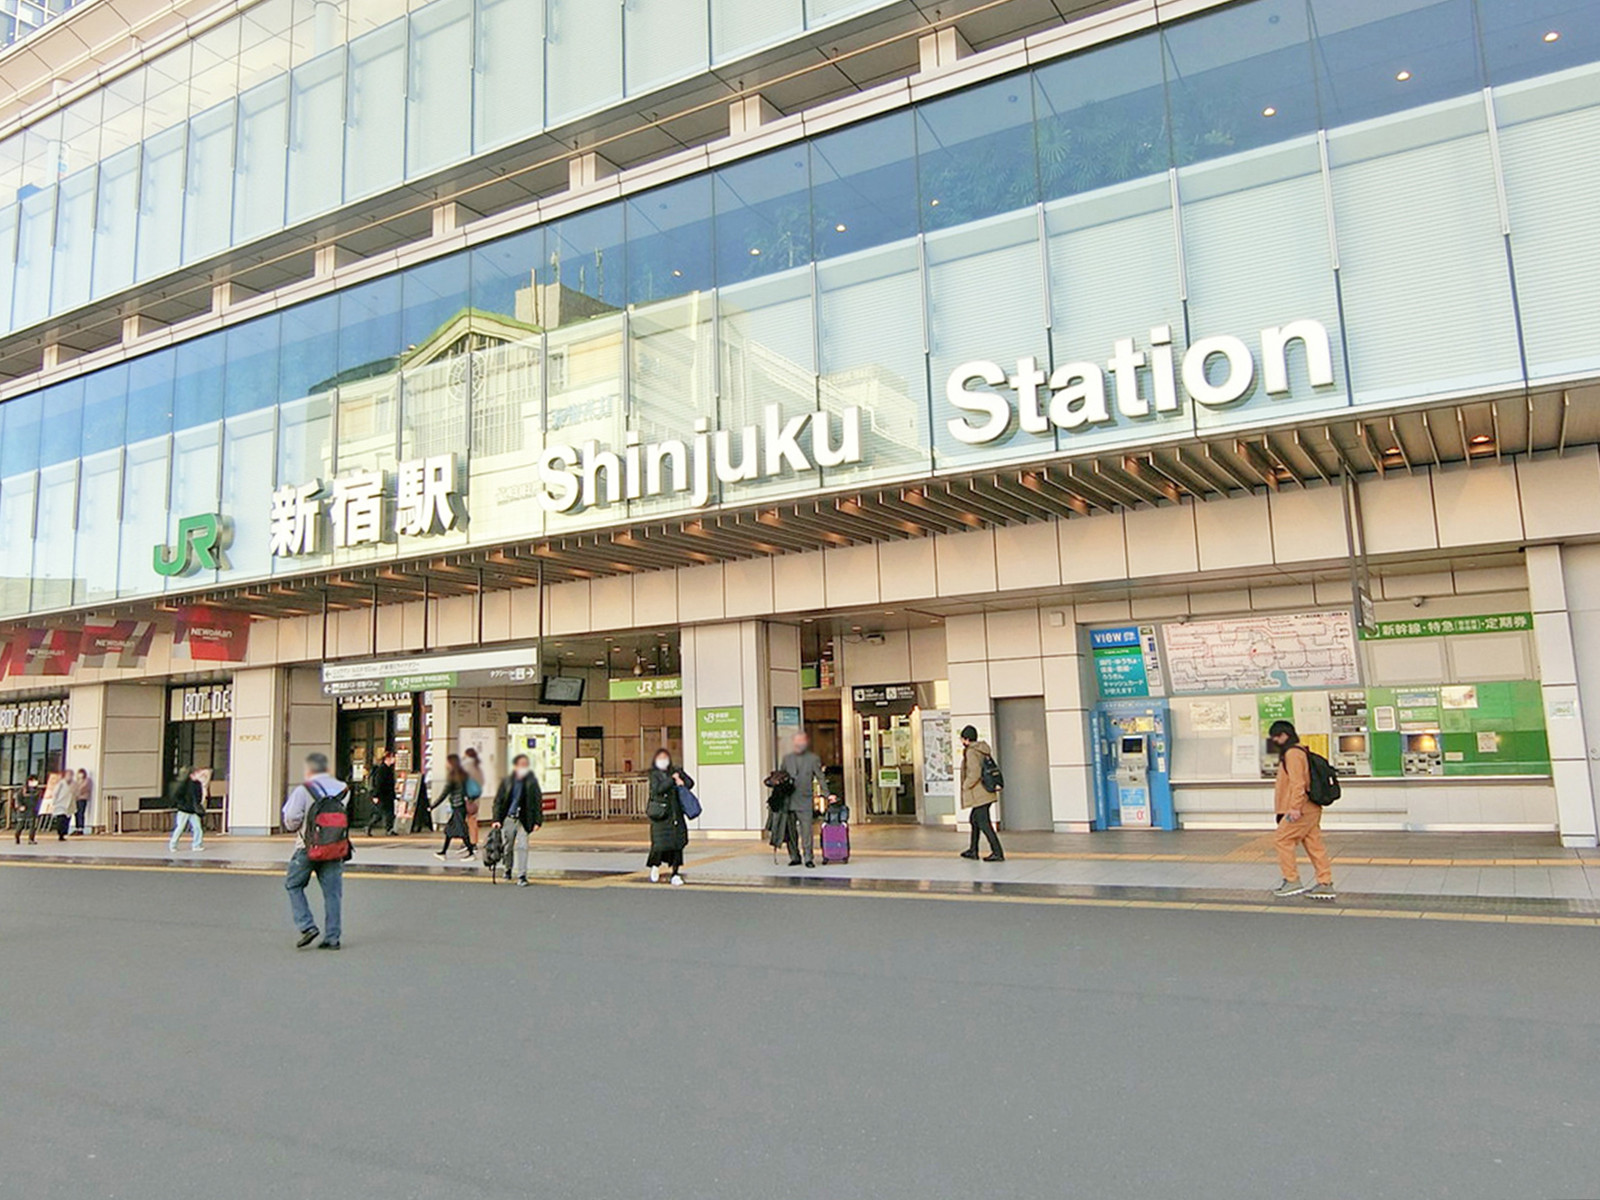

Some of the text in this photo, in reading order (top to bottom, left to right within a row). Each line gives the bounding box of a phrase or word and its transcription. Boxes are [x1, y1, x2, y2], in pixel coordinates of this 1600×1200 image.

[153, 319, 1333, 577] JR 新宿駅 Shinjuku Station
[20, 704, 67, 727] DEGREES
